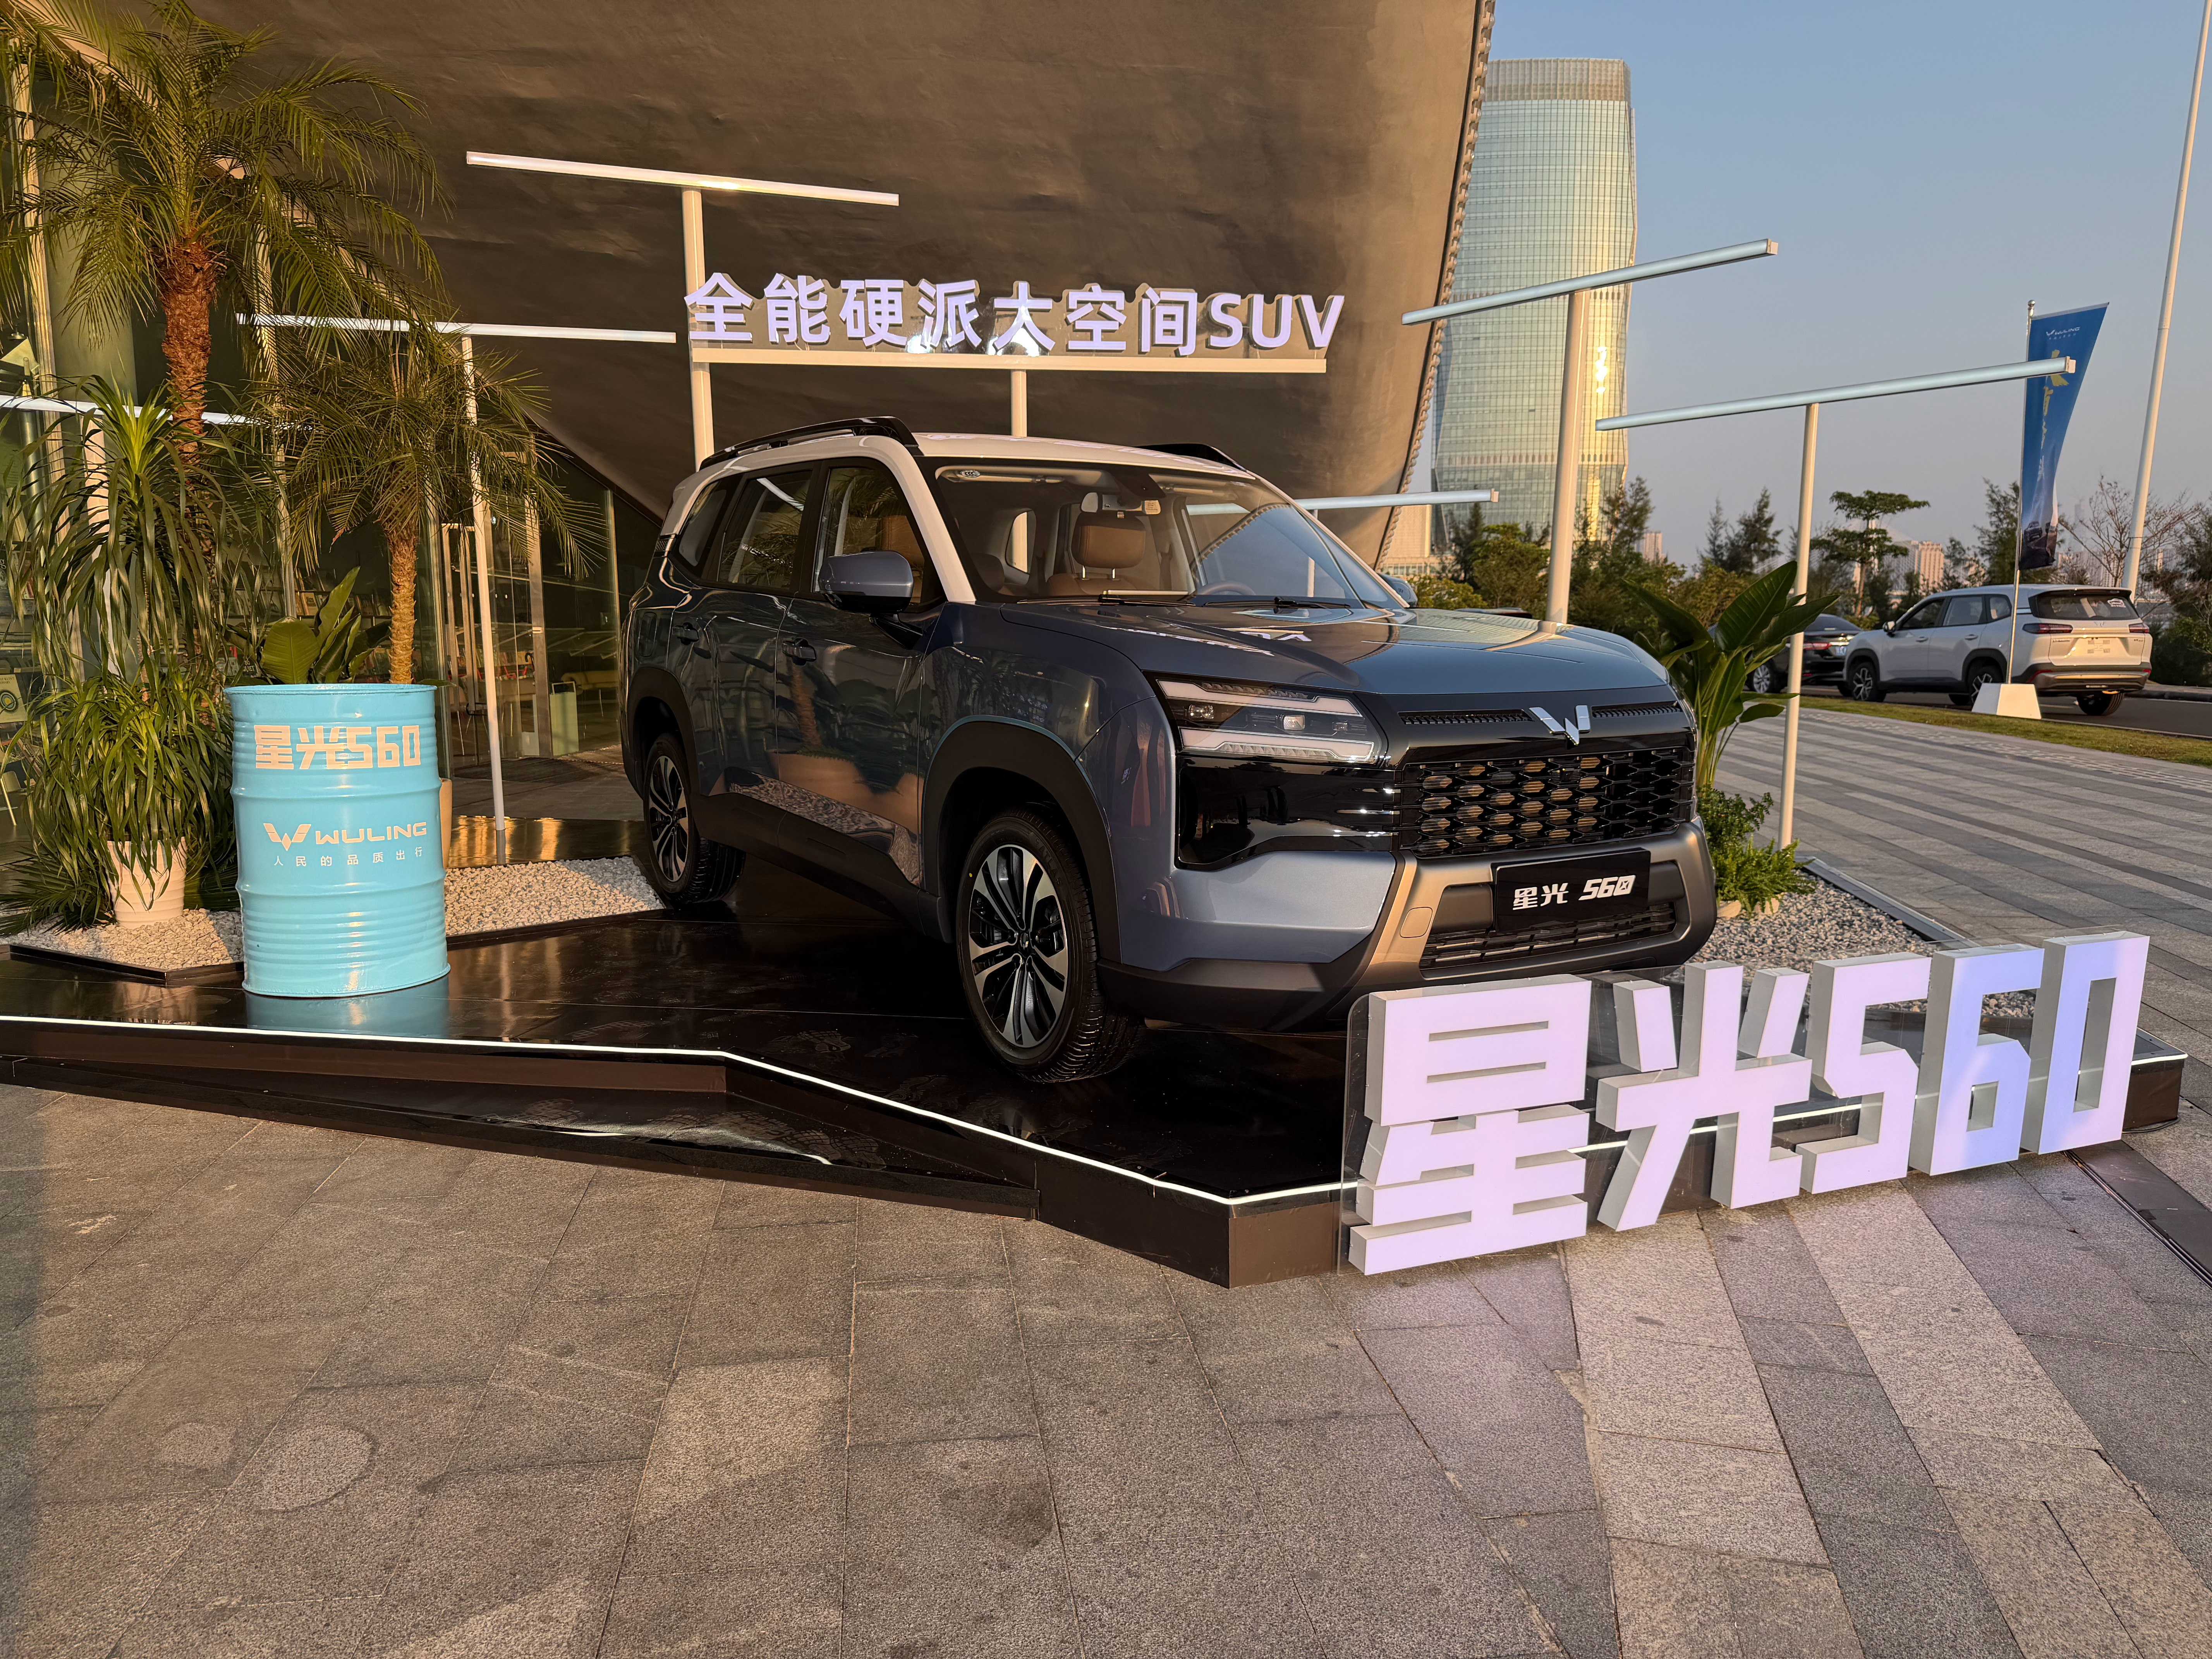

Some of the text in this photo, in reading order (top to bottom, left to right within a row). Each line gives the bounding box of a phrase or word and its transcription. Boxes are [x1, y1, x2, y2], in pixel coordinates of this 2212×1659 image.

[684, 273, 1344, 356] 全能硬派大空间SUV
[254, 725, 421, 770] 星光560
[316, 822, 426, 845] WULING
[274, 847, 423, 867] 人民的品质出行
[1513, 875, 1637, 910] 星光 560
[1349, 931, 2150, 1276] 星光560
